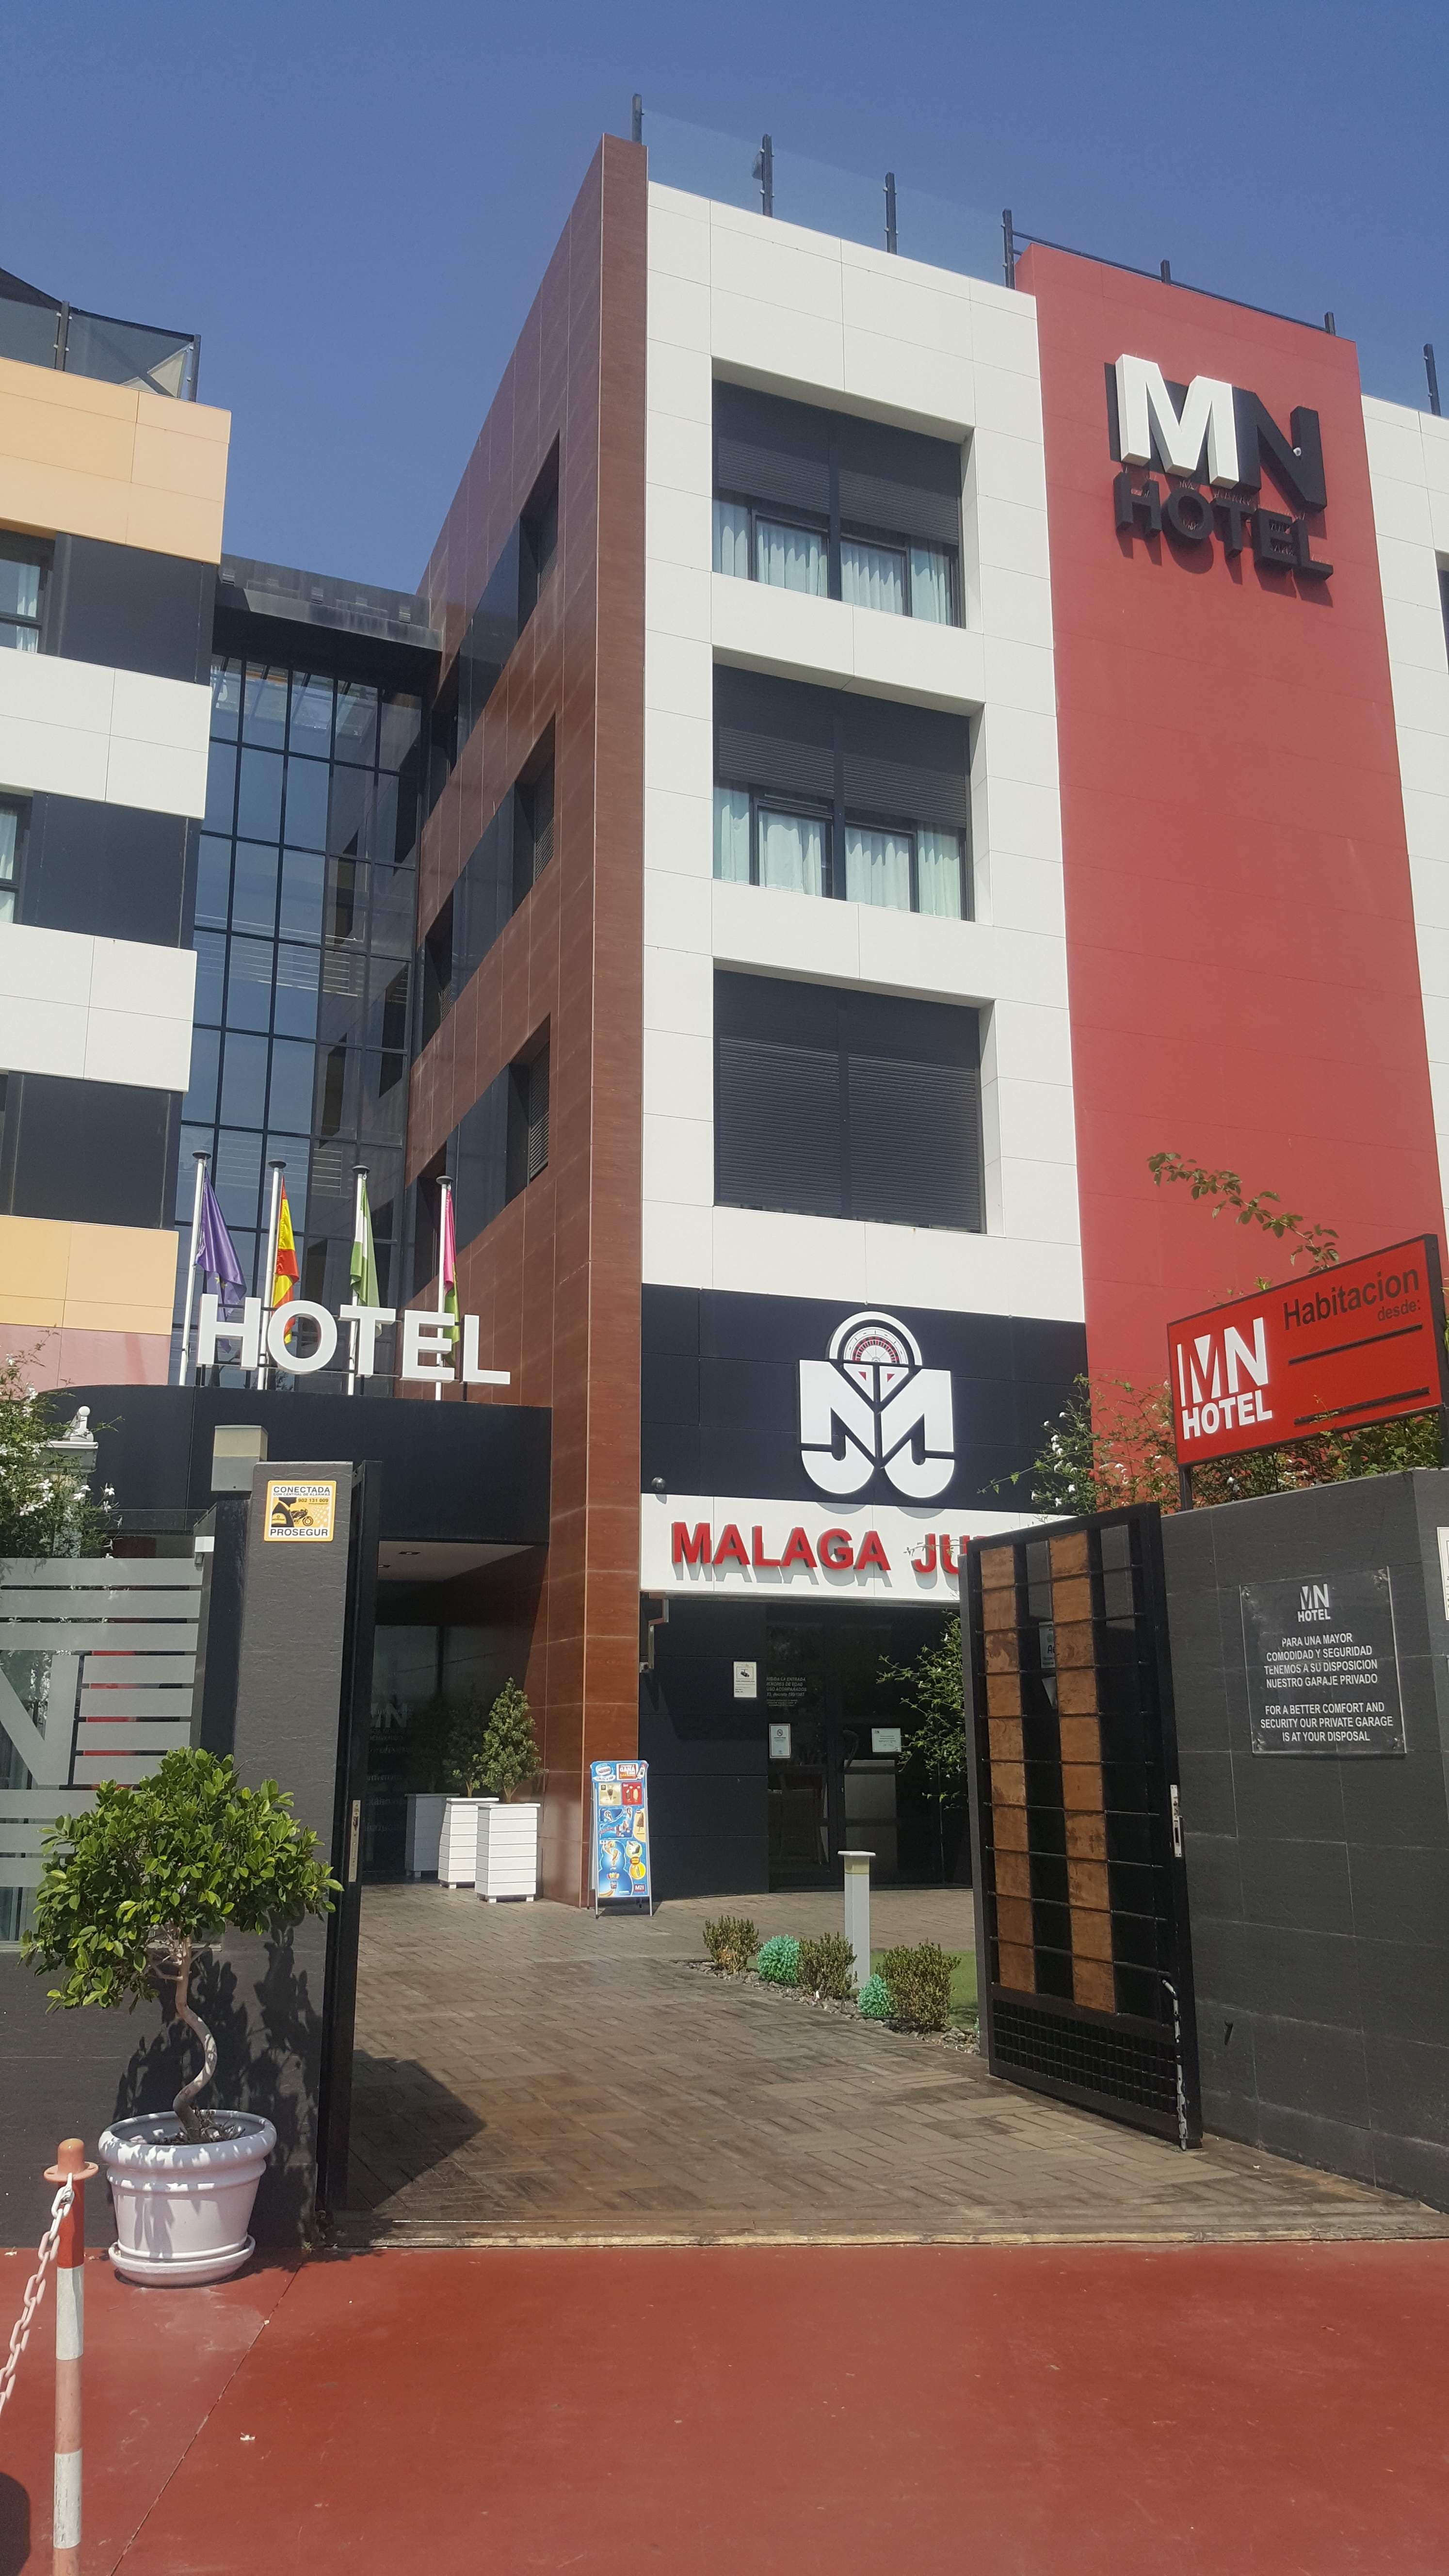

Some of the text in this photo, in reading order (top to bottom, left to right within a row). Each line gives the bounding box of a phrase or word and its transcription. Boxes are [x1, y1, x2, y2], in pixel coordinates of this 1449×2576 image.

[1115, 354, 1327, 514] MN
[1113, 470, 1334, 583] HOTEL
[1283, 1268, 1419, 1330] Habitacion
[1377, 1298, 1421, 1321] desde:
[196, 1293, 511, 1385] HOTEL
[1176, 1317, 1269, 1407] MN
[1182, 1389, 1273, 1440] HOTEL
[671, 1521, 987, 1575] MALAGA JU
[1298, 1608, 1331, 1622] HOTEL
[1282, 1633, 1352, 1647] PARA UNA MAYOR
[1267, 1645, 1372, 1662] COMODIDAD Y SEGURIDAD
[1264, 1659, 1378, 1675] TENEMOS A SU DISPOSICION
[1267, 1673, 1378, 1688] NUESTRO GARAJE PRIVADO
[1265, 1702, 1385, 1715] FOR A BETTER COMFORT AND
[1261, 1716, 1393, 1728] SECURITY OUR PRIVATE GARAGE
[1282, 1731, 1370, 1742] IS AT YOUR DISPOSAL
